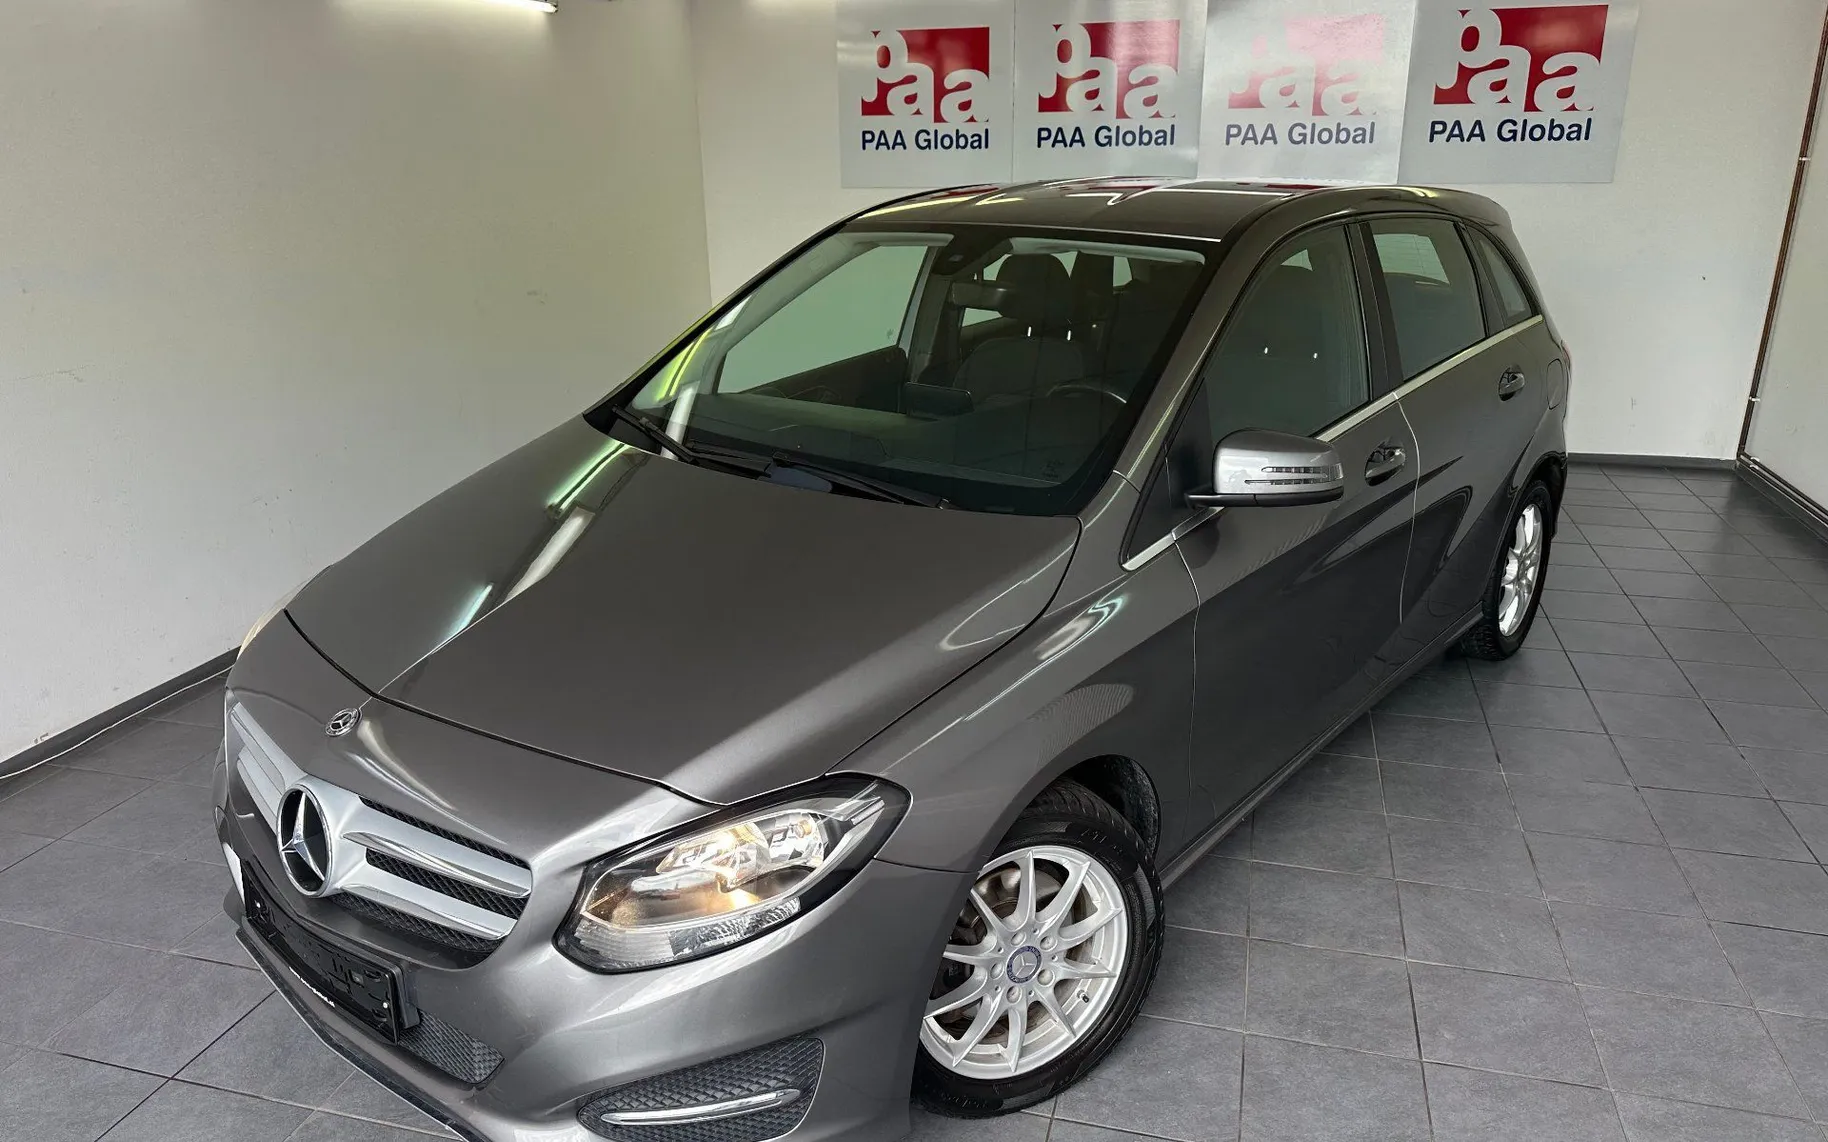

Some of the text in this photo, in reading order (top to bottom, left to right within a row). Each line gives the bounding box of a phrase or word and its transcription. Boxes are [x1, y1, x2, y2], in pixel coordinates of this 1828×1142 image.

[860, 127, 989, 151] PAA Global
[1036, 124, 1176, 149] PAA Global
[1225, 121, 1376, 146] PAA Global
[1428, 117, 1593, 143] PAA Global
